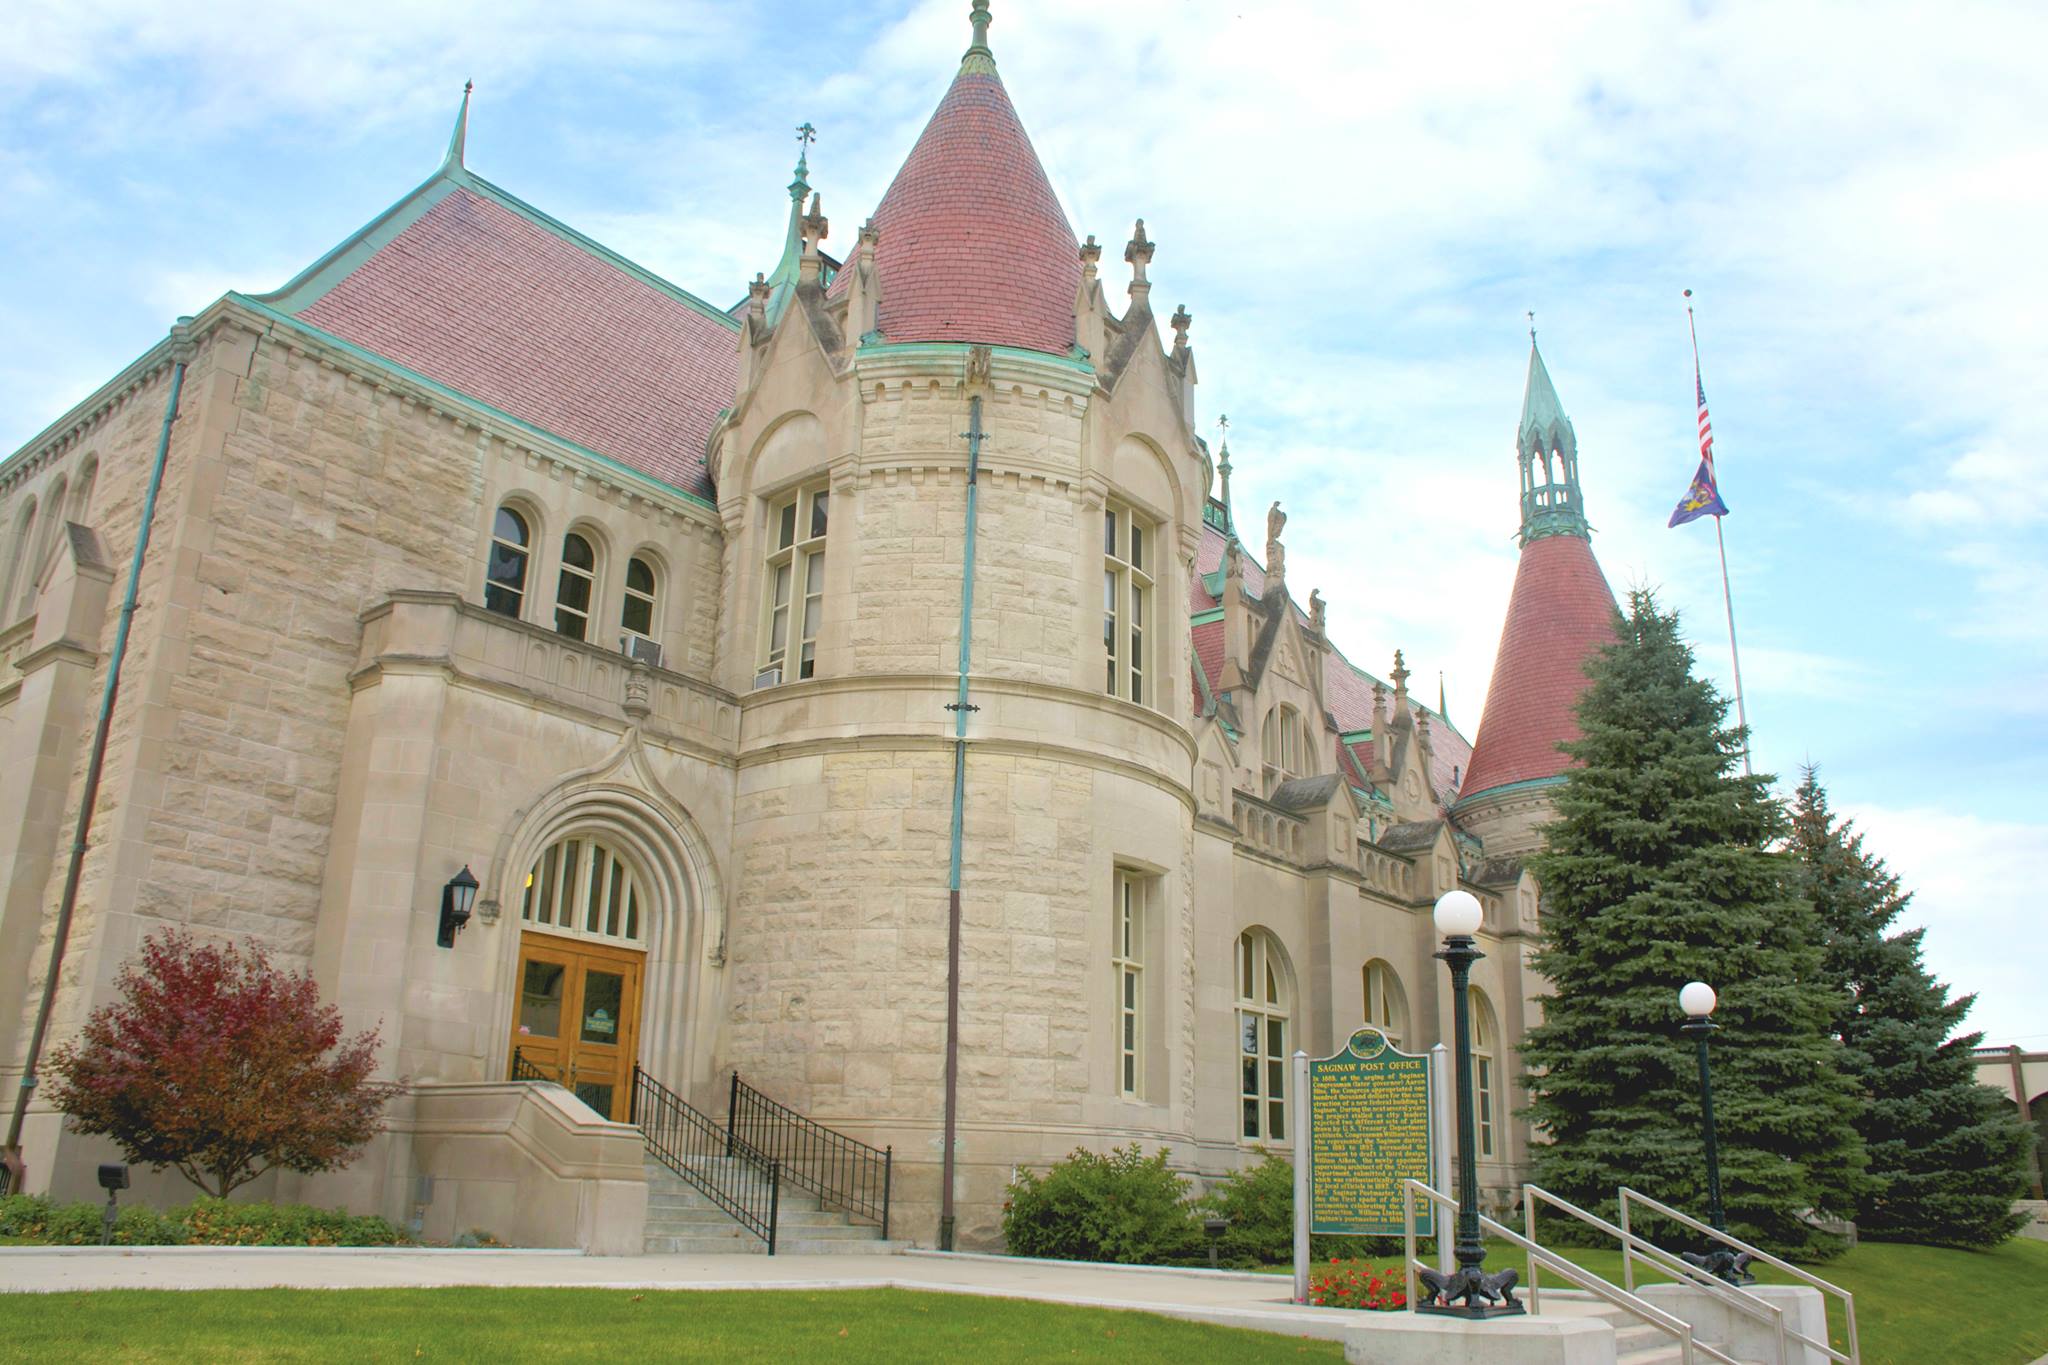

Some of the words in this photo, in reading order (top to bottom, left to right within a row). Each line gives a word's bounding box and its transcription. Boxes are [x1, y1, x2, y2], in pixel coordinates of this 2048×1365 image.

[1318, 1064, 1356, 1072] SAGINAW
[1360, 1062, 1384, 1071] POST
[1388, 1061, 1421, 1070] OFFICE
